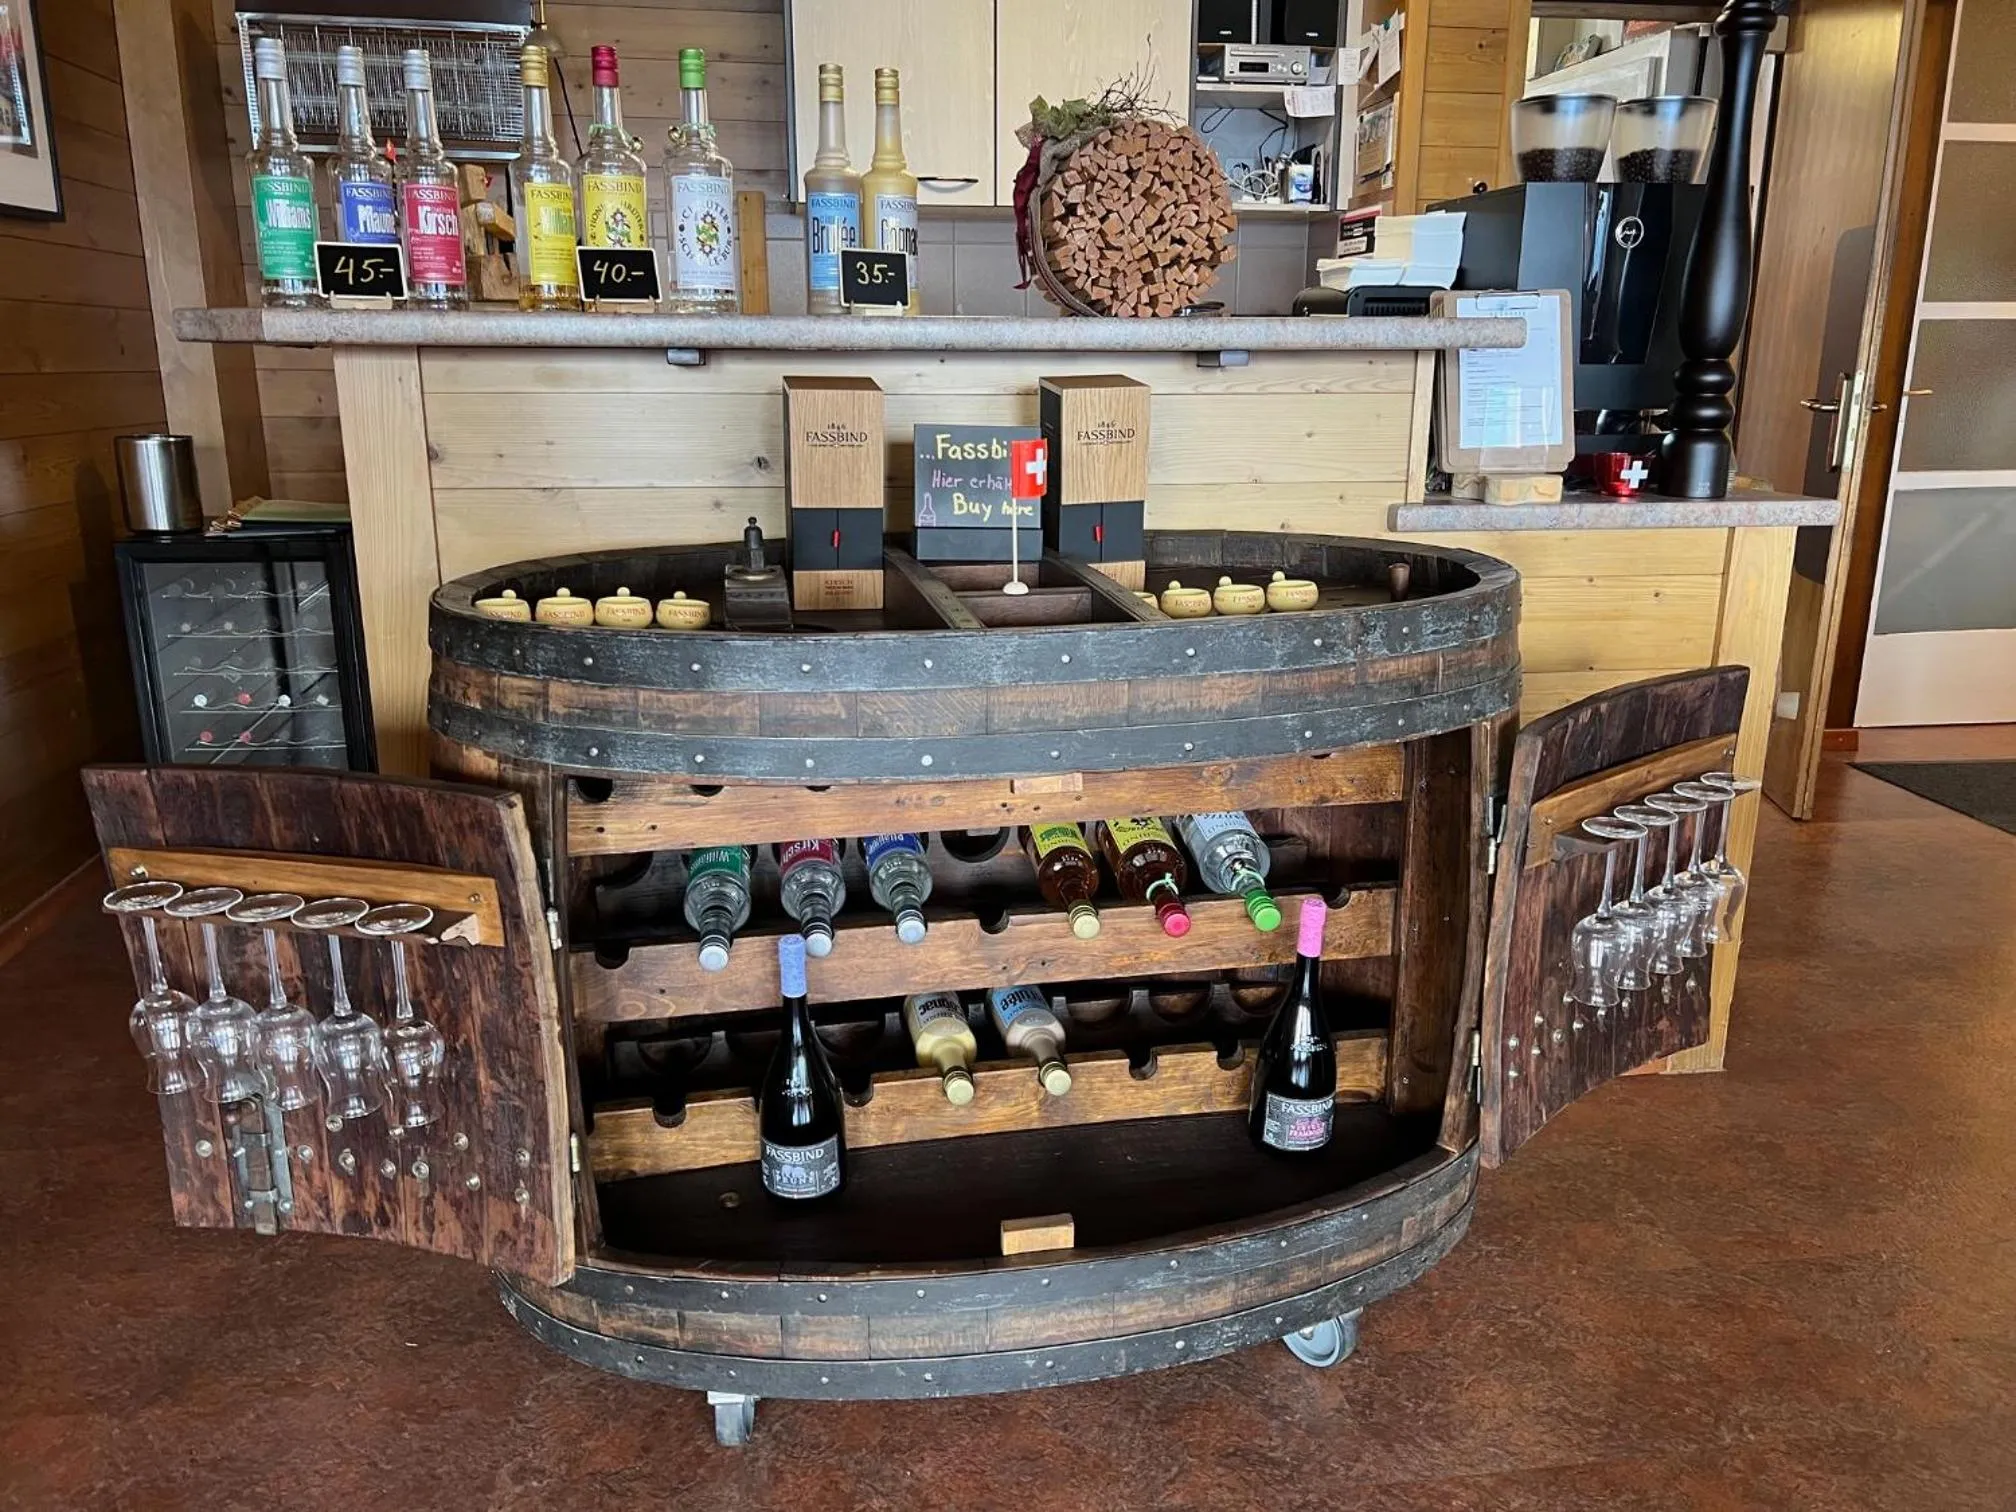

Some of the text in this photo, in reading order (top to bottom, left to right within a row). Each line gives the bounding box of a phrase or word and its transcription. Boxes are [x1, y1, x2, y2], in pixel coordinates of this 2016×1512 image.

[417, 205, 459, 236] Kirsch
[333, 256, 395, 285] 45.-
[593, 260, 645, 284] 40.-
[856, 261, 896, 285] 35.-
[805, 431, 868, 443] FASSBIND
[1077, 428, 1135, 441] FASSBIND
[931, 468, 964, 489] Hier
[952, 492, 992, 523] Buy
[766, 1145, 824, 1162] FASSBIND
